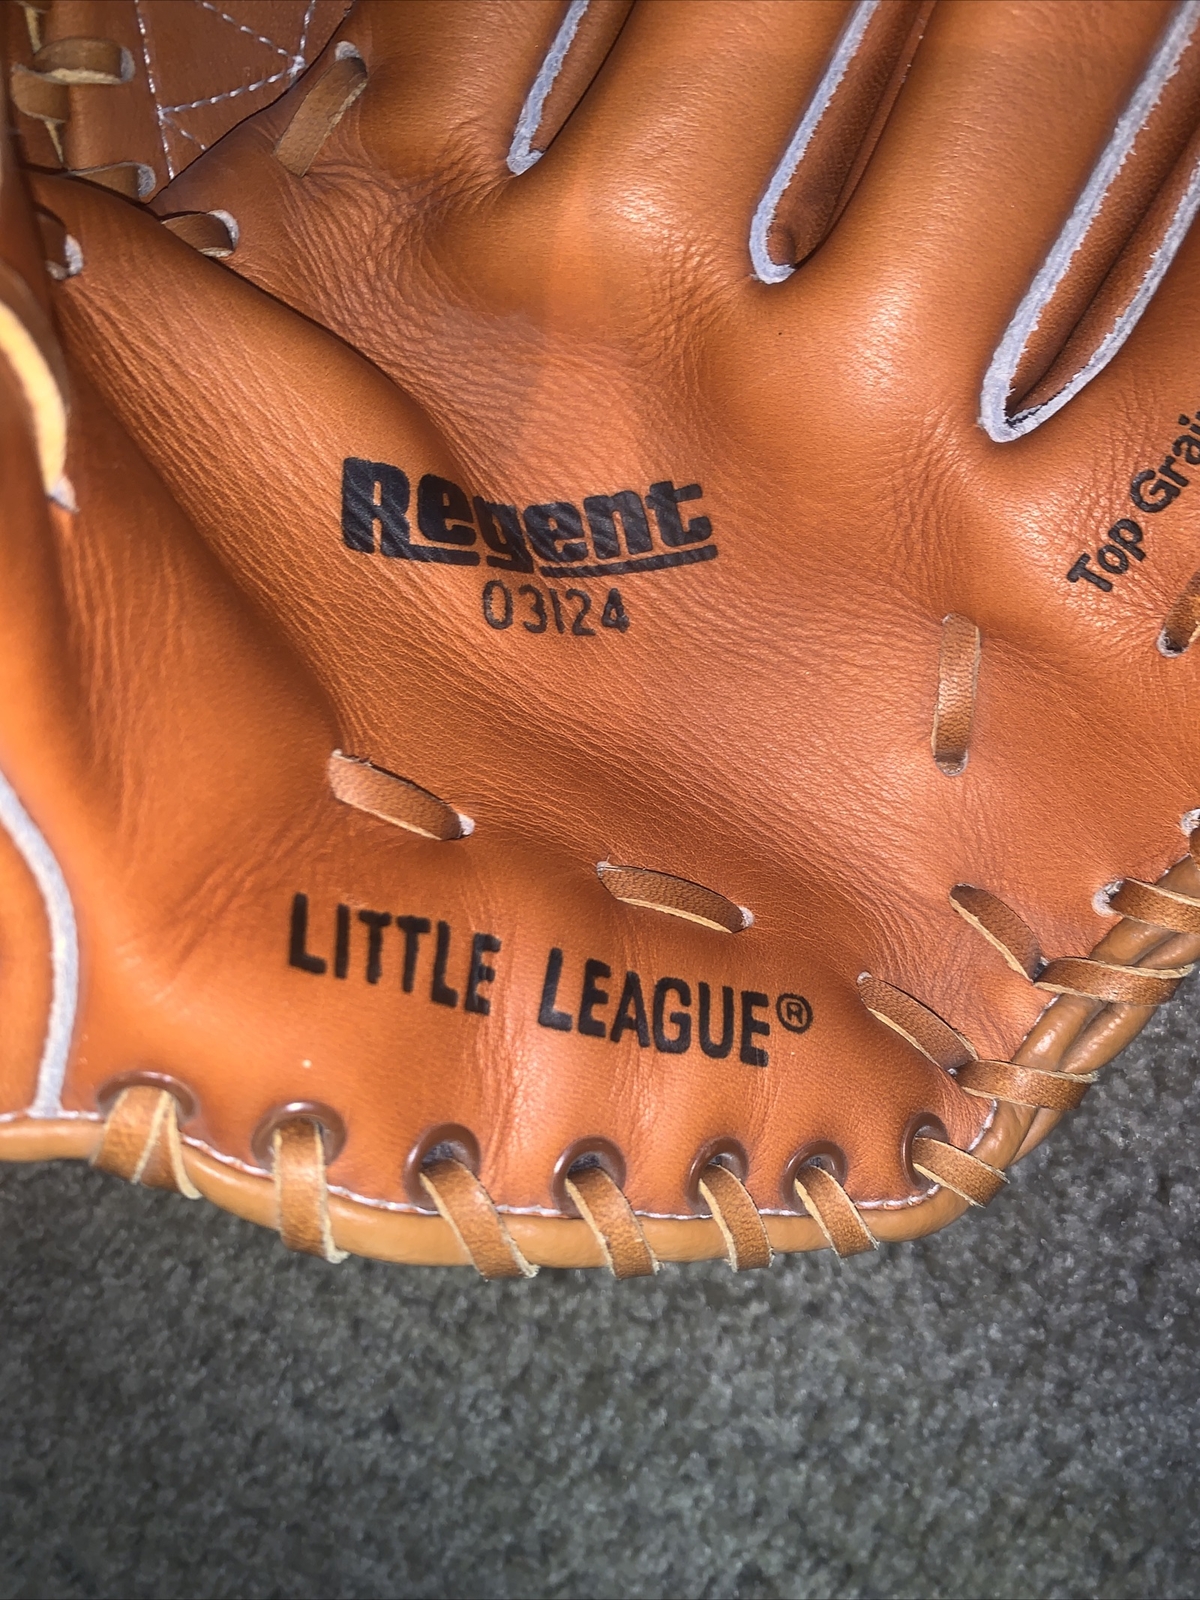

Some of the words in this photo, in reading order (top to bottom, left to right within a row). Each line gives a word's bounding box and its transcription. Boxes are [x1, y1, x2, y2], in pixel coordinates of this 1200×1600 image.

[341, 457, 718, 578] Regent
[1067, 518, 1146, 592] Top
[1131, 411, 1200, 513] Grai
[482, 580, 630, 636] 03124
[288, 893, 501, 1015] LITTLE
